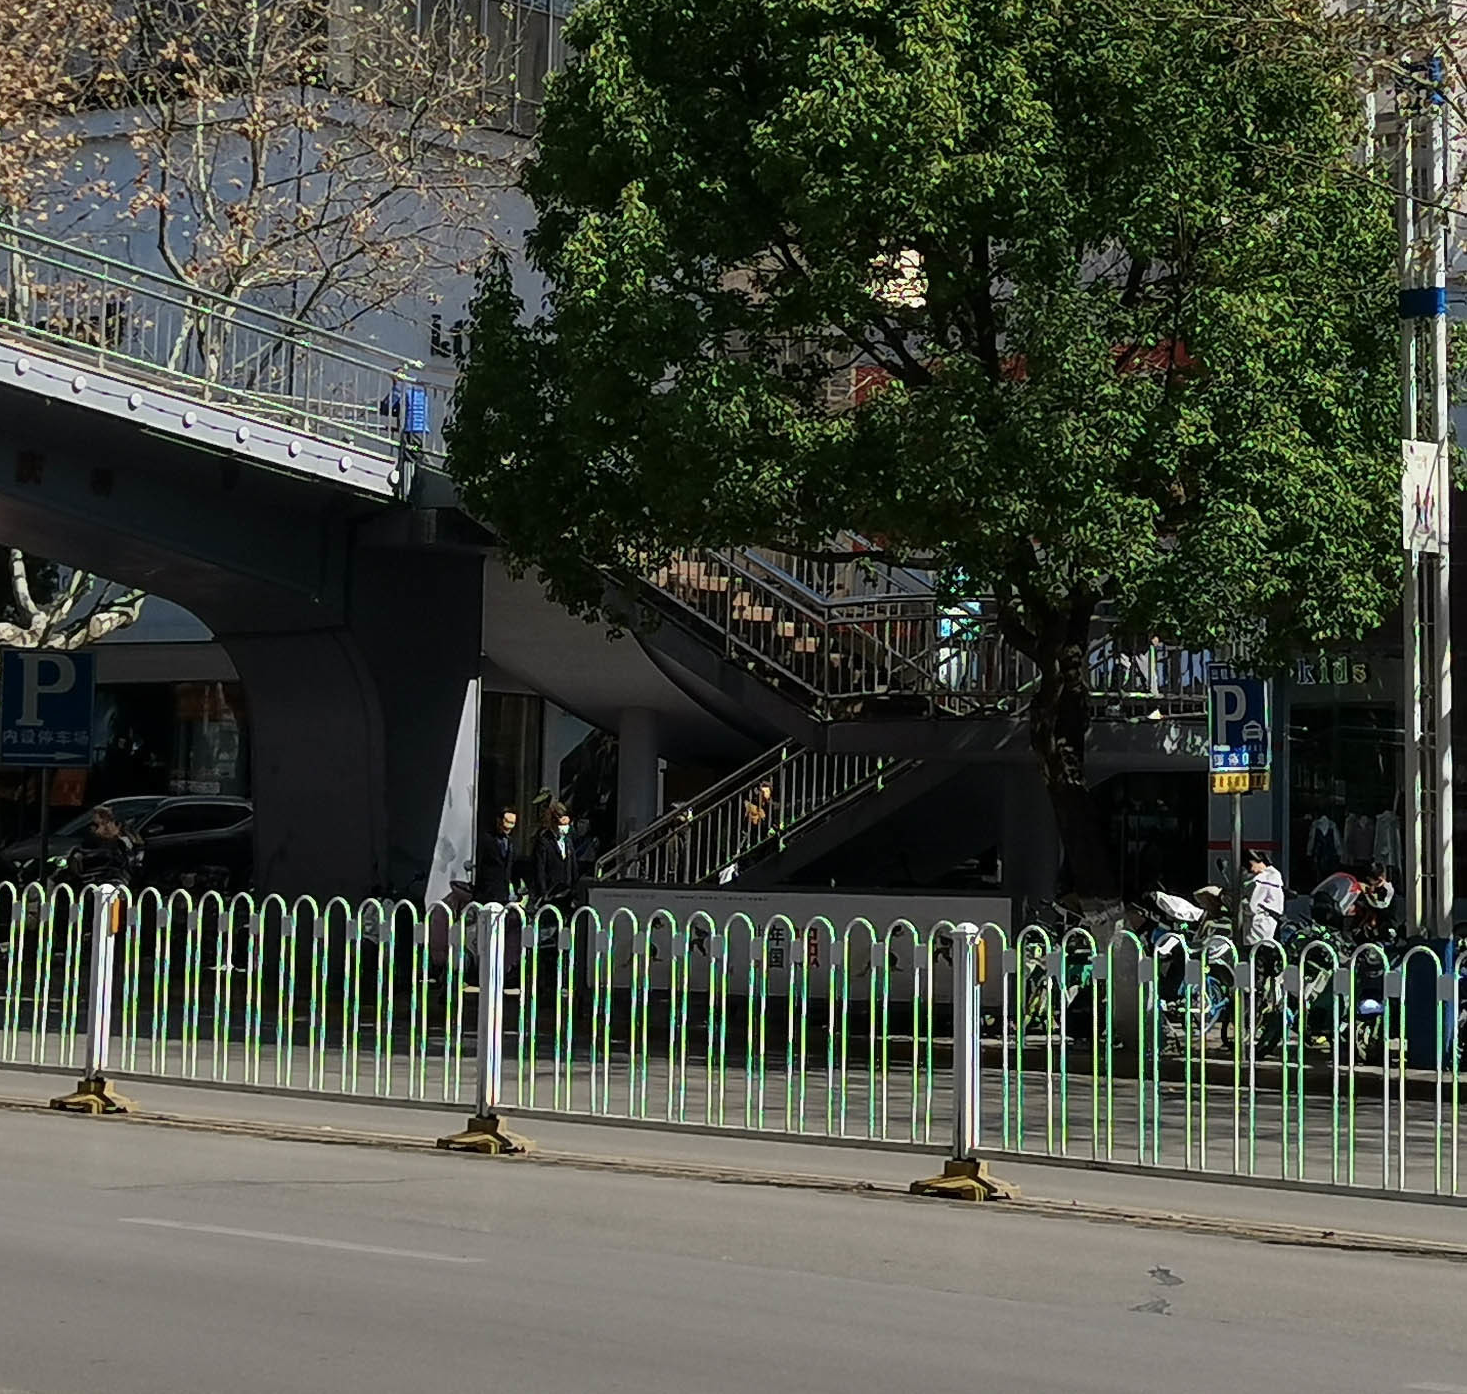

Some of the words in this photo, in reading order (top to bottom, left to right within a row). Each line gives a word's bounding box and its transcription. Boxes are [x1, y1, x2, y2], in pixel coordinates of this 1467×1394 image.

[15, 653, 77, 727] P
[1296, 656, 1366, 684] kids
[1213, 684, 1247, 745] P
[3, 729, 90, 745] 内设停车场
